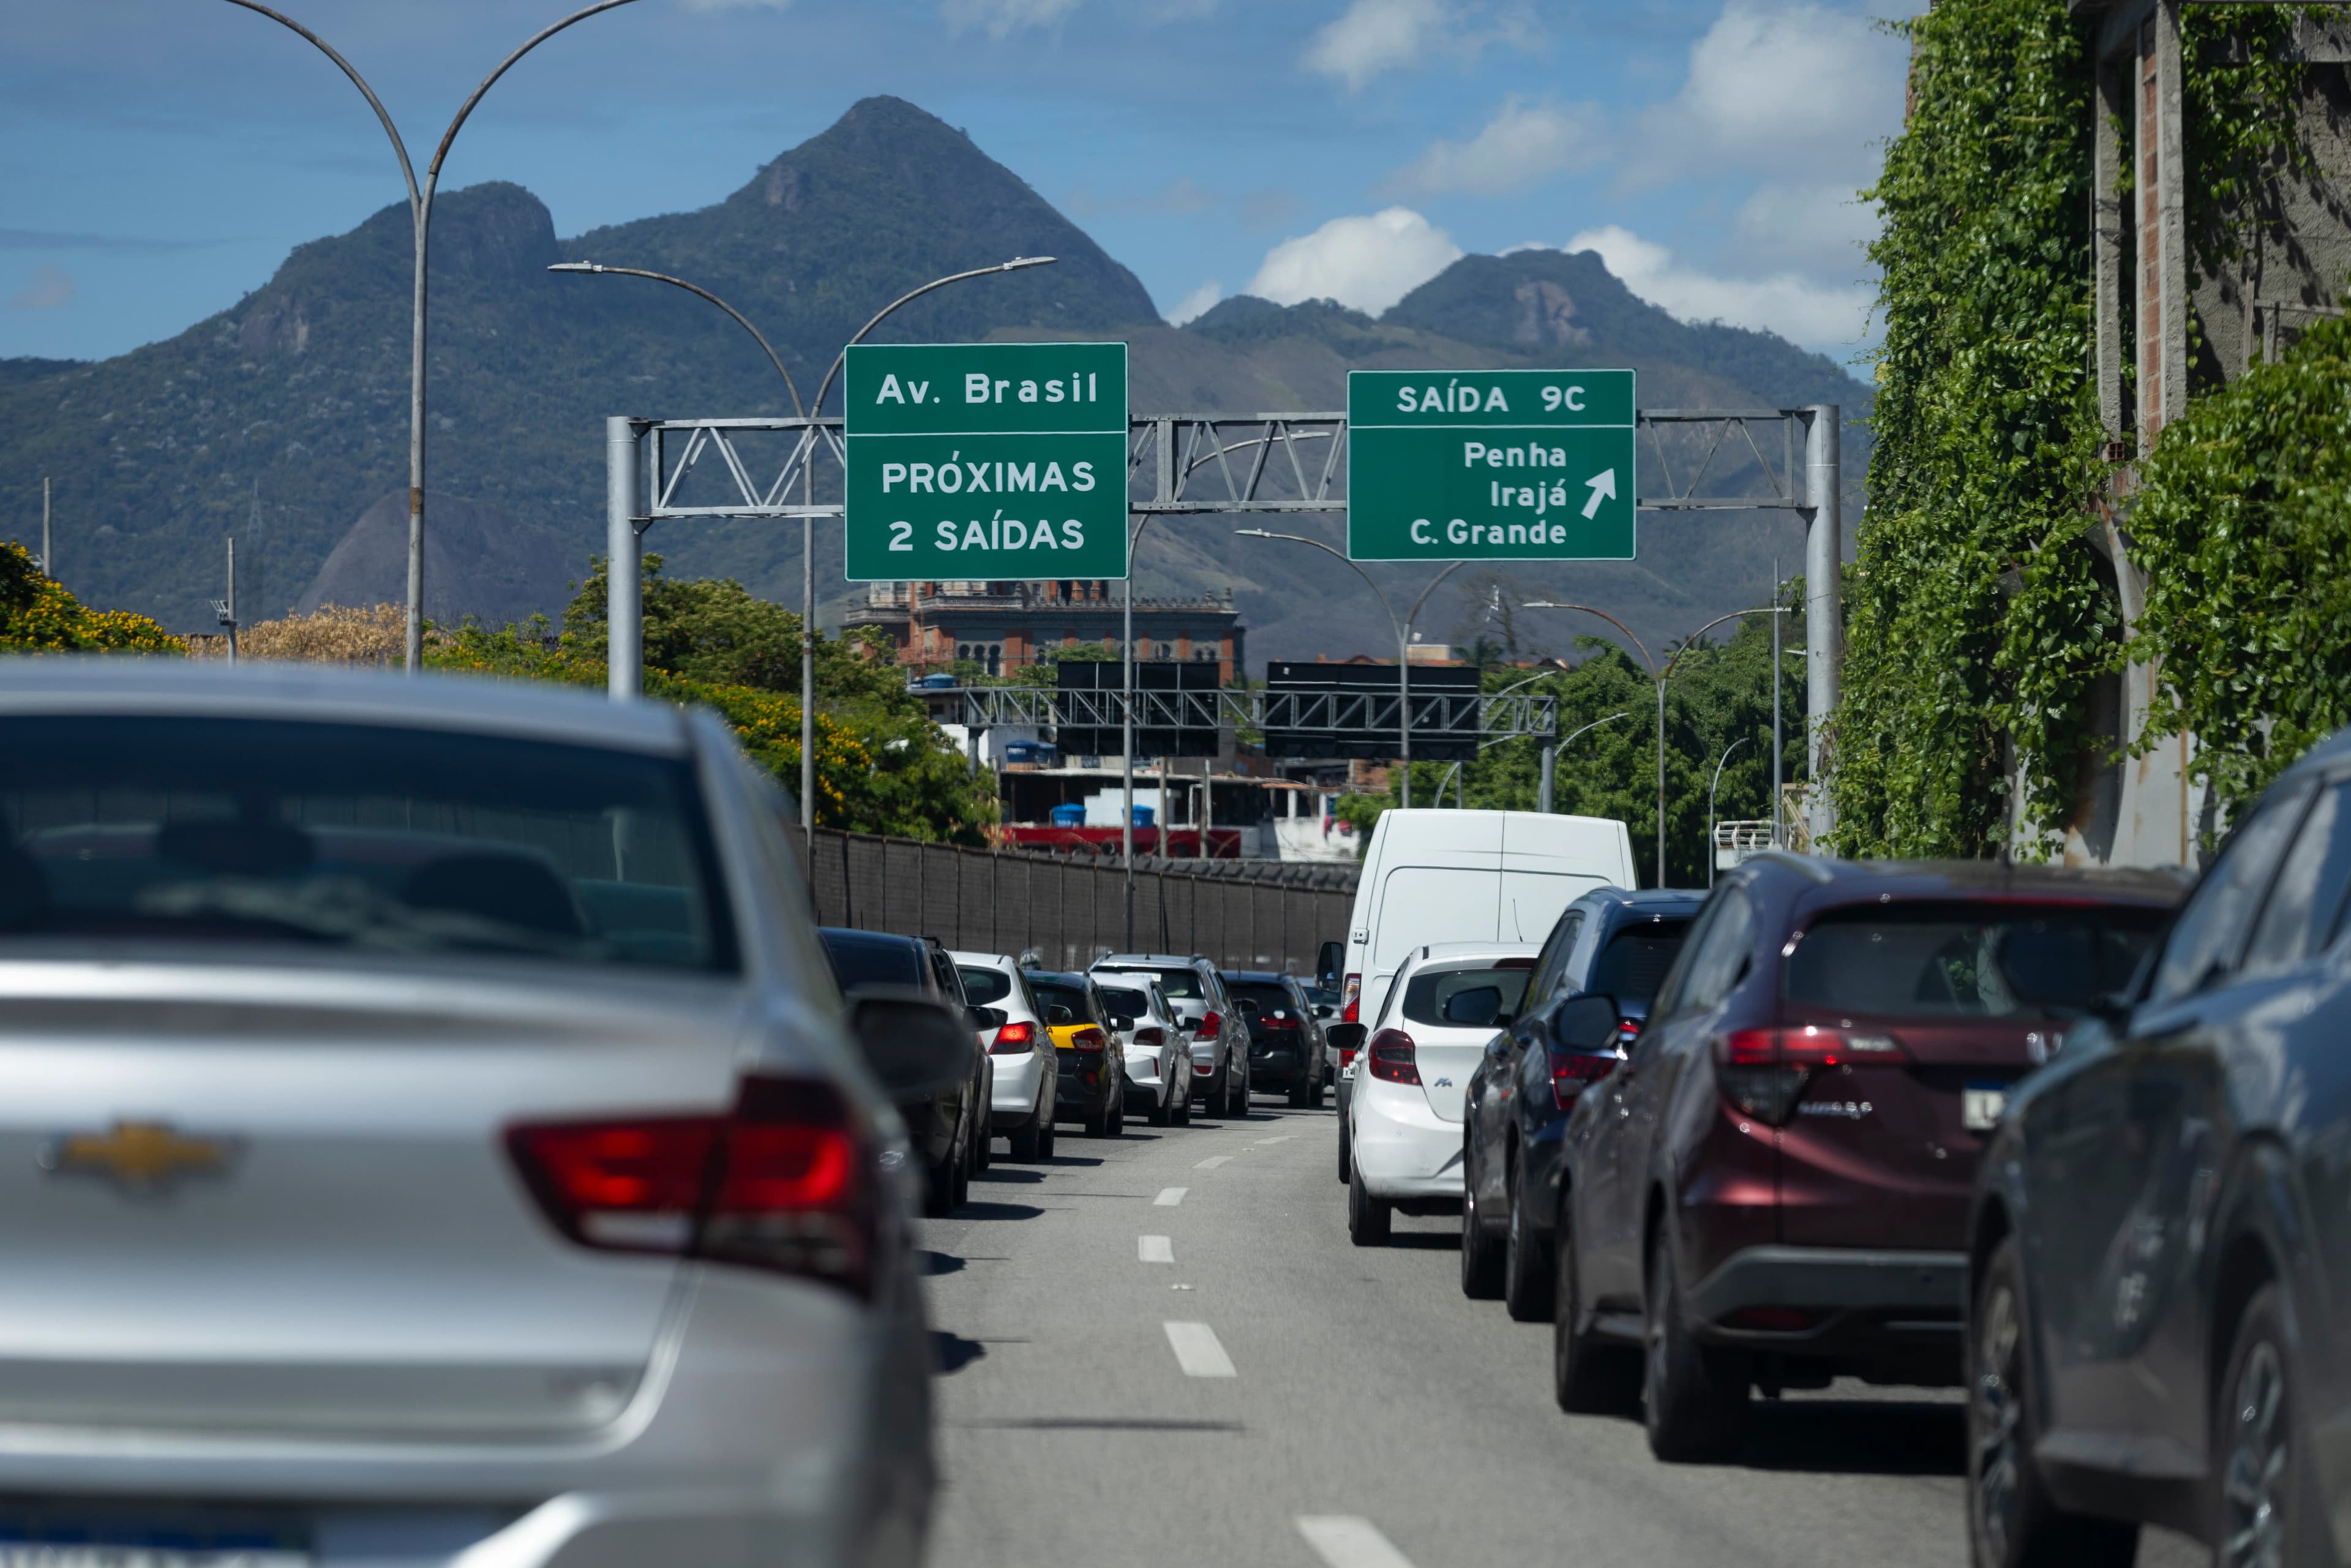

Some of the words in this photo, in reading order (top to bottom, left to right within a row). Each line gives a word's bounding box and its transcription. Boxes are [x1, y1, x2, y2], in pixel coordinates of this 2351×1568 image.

[876, 374, 940, 404] Av.
[966, 372, 1096, 403] Brasil
[1397, 378, 1509, 413] SAÍDA
[1541, 386, 1586, 411] 9C
[882, 451, 1095, 493] PRÓXIMAS
[1464, 442, 1566, 468] Penha
[1491, 479, 1566, 515] Irajá
[888, 521, 913, 551] 2
[934, 509, 1084, 551] SAÍDAS
[1411, 519, 1439, 544] C.
[1447, 519, 1567, 544] Grande
